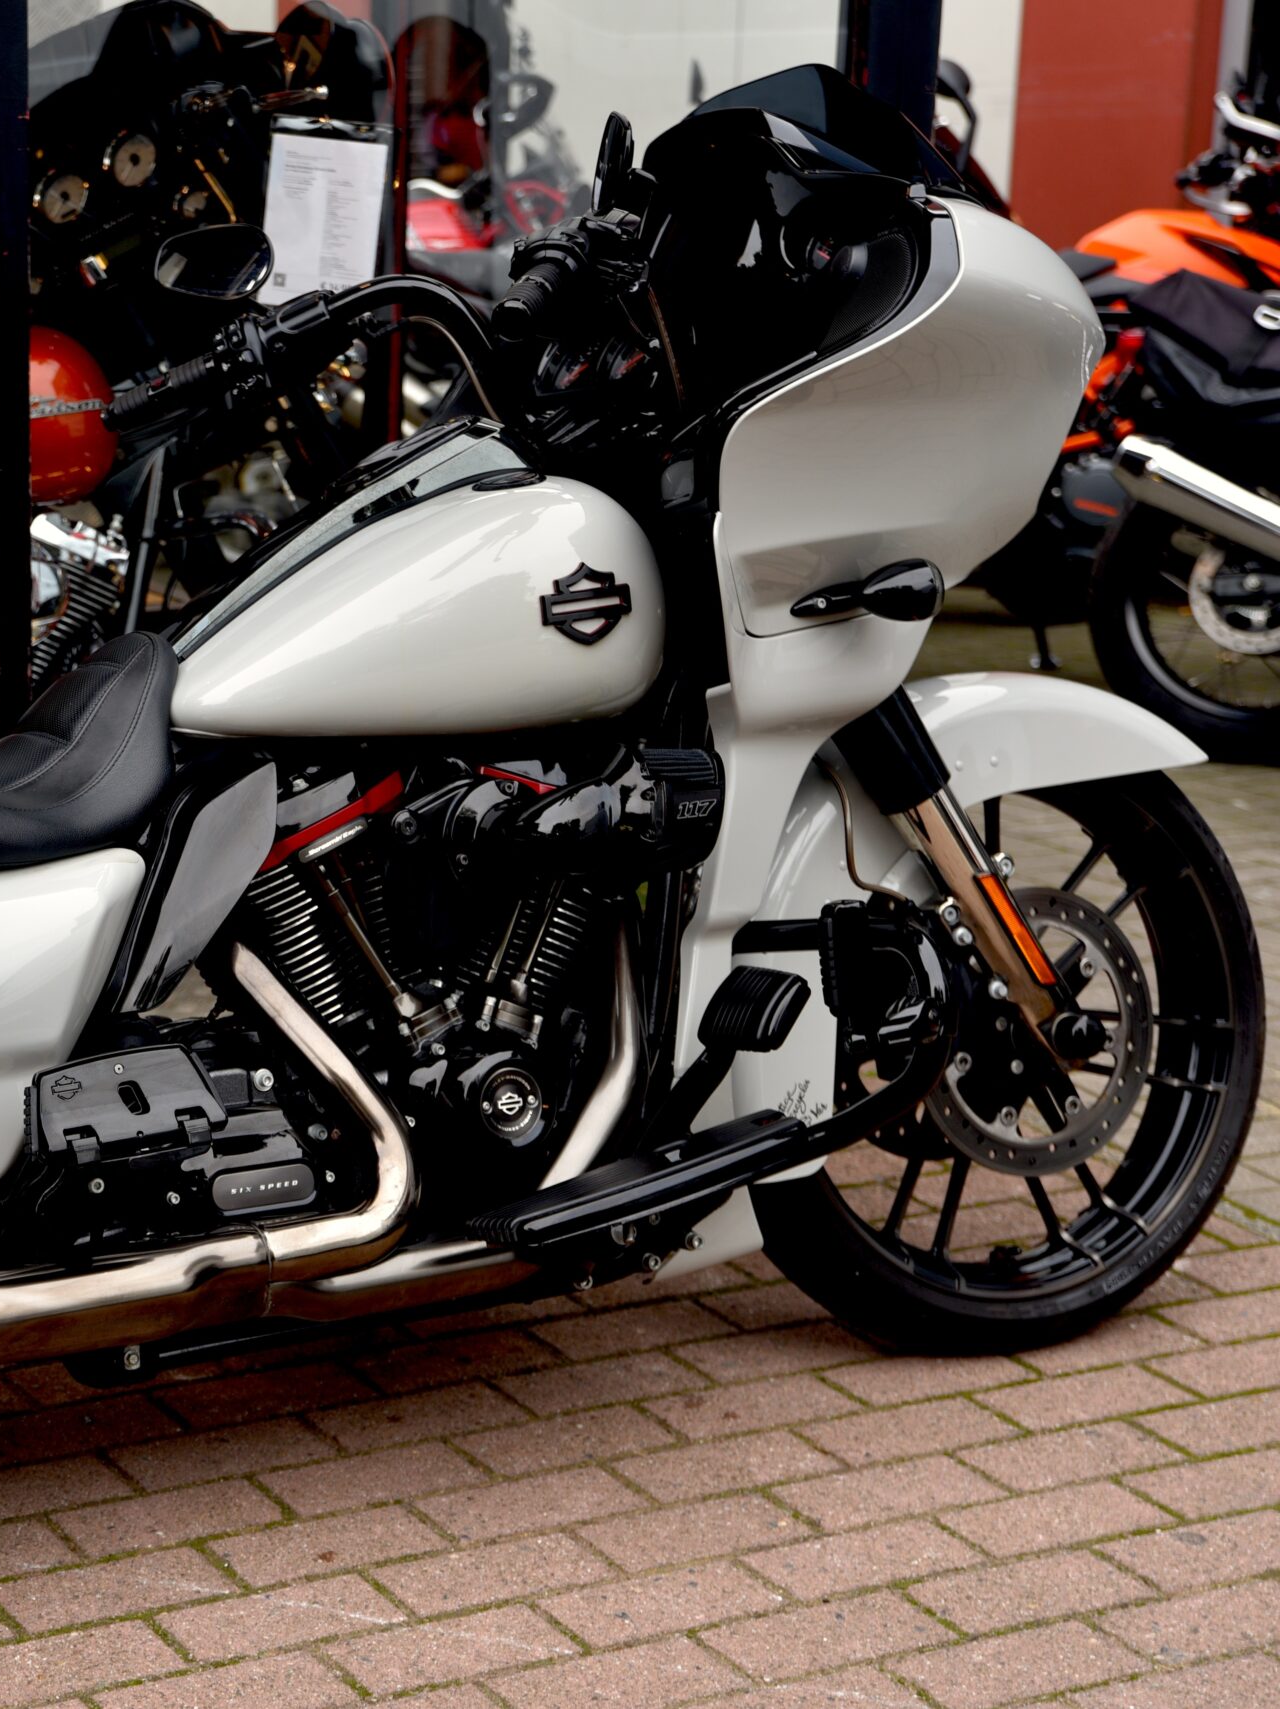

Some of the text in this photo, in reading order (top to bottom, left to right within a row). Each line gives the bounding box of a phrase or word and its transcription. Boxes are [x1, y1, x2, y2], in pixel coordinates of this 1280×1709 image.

[677, 798, 717, 820] 117
[230, 1179, 299, 1195] SIX SPEED
